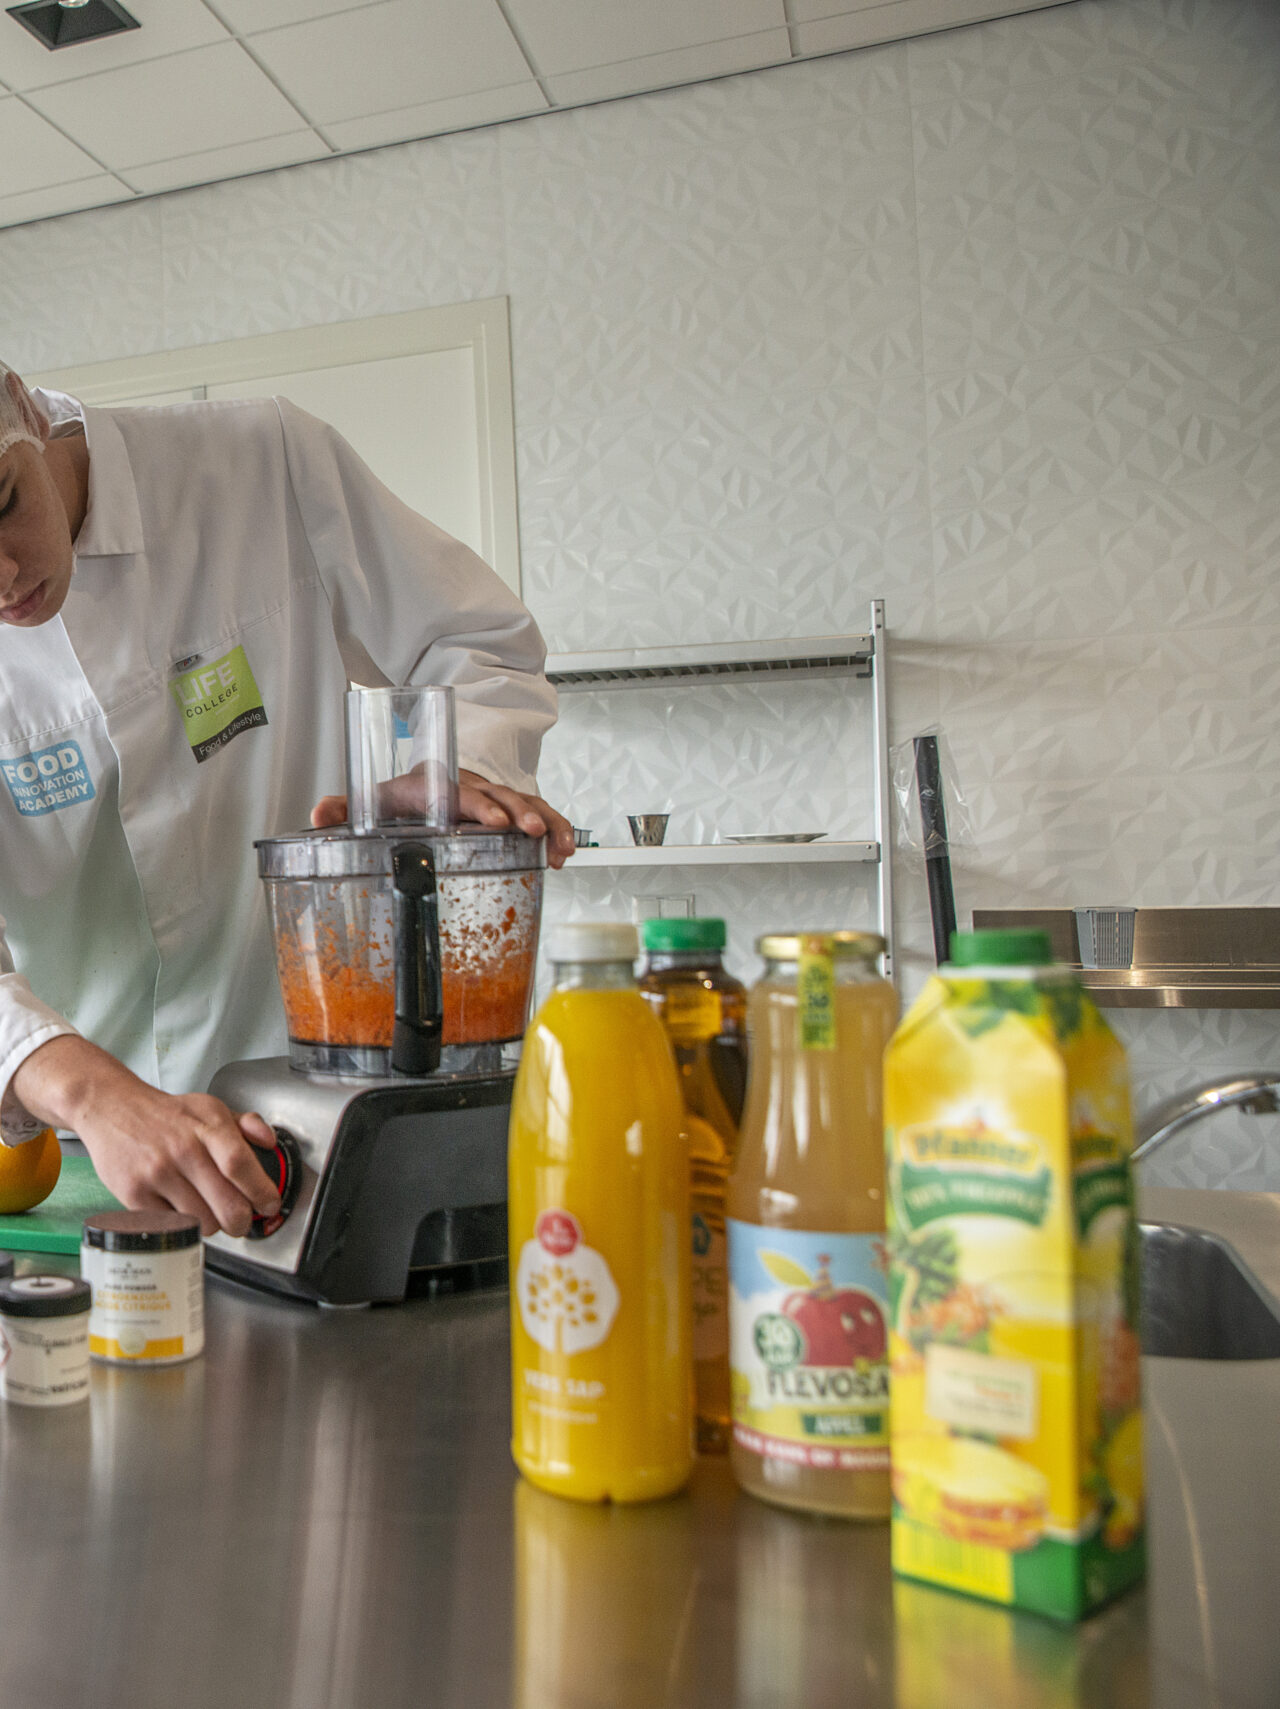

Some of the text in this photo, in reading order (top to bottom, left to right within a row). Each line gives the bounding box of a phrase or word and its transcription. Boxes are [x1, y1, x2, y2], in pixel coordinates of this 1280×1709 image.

[175, 661, 235, 705] LIFE
[185, 683, 238, 718] COLLEGE
[199, 737, 222, 757] Food
[228, 712, 262, 736] Lifestyle
[2, 747, 80, 783] FOOD
[19, 782, 89, 812] ACADEMY
[767, 1368, 890, 1400] FLEVOSA
